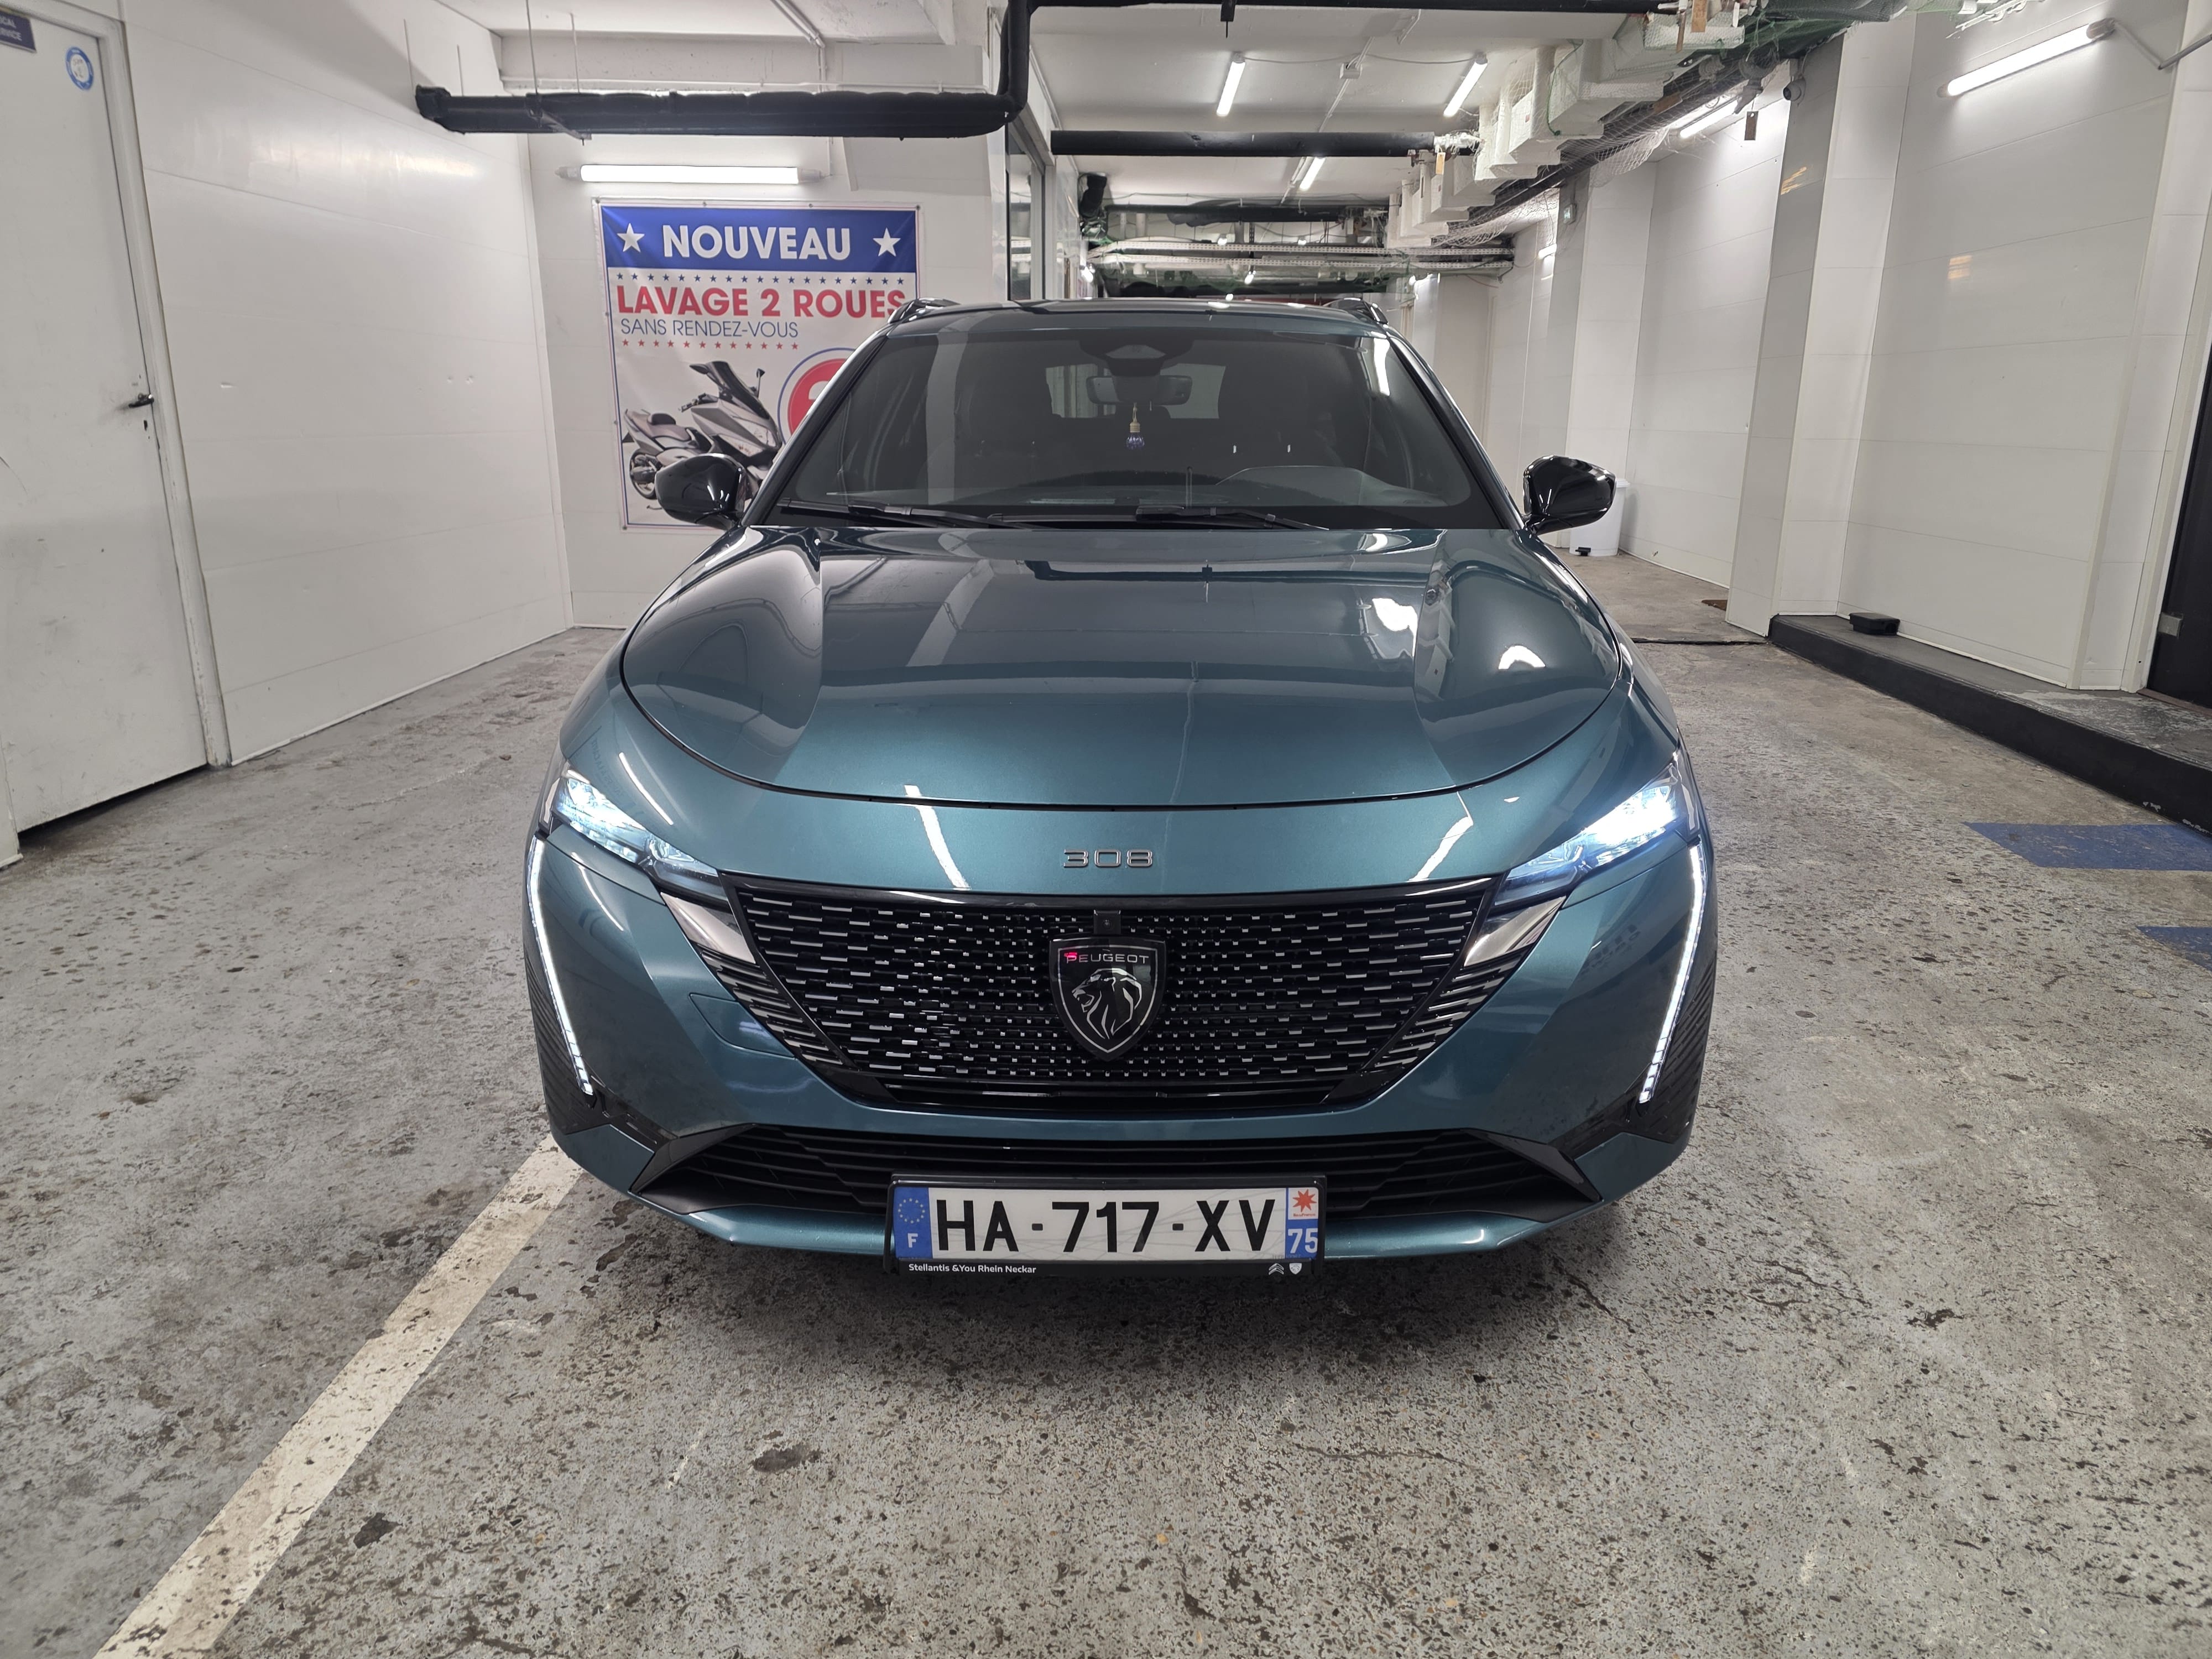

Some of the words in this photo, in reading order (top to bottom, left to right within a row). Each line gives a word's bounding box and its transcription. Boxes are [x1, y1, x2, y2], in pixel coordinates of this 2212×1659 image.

[662, 225, 851, 260] NOUVEAU
[617, 285, 749, 317] LAVAGE
[761, 288, 781, 317] 2
[794, 289, 906, 319] ROUES
[620, 318, 667, 336] SANS
[673, 320, 799, 338] RENDEZ-VOUS
[1063, 849, 1153, 868] 308
[1065, 953, 1149, 964] PEUGEOT
[936, 1199, 1275, 1253] HA-717-XV
[907, 1233, 919, 1248] F
[1287, 1228, 1318, 1254] 75
[909, 1263, 950, 1272] Stellantis
[952, 1264, 976, 1273] &You
[978, 1264, 1003, 1273] Rhein
[1005, 1265, 1037, 1274] Neckar
